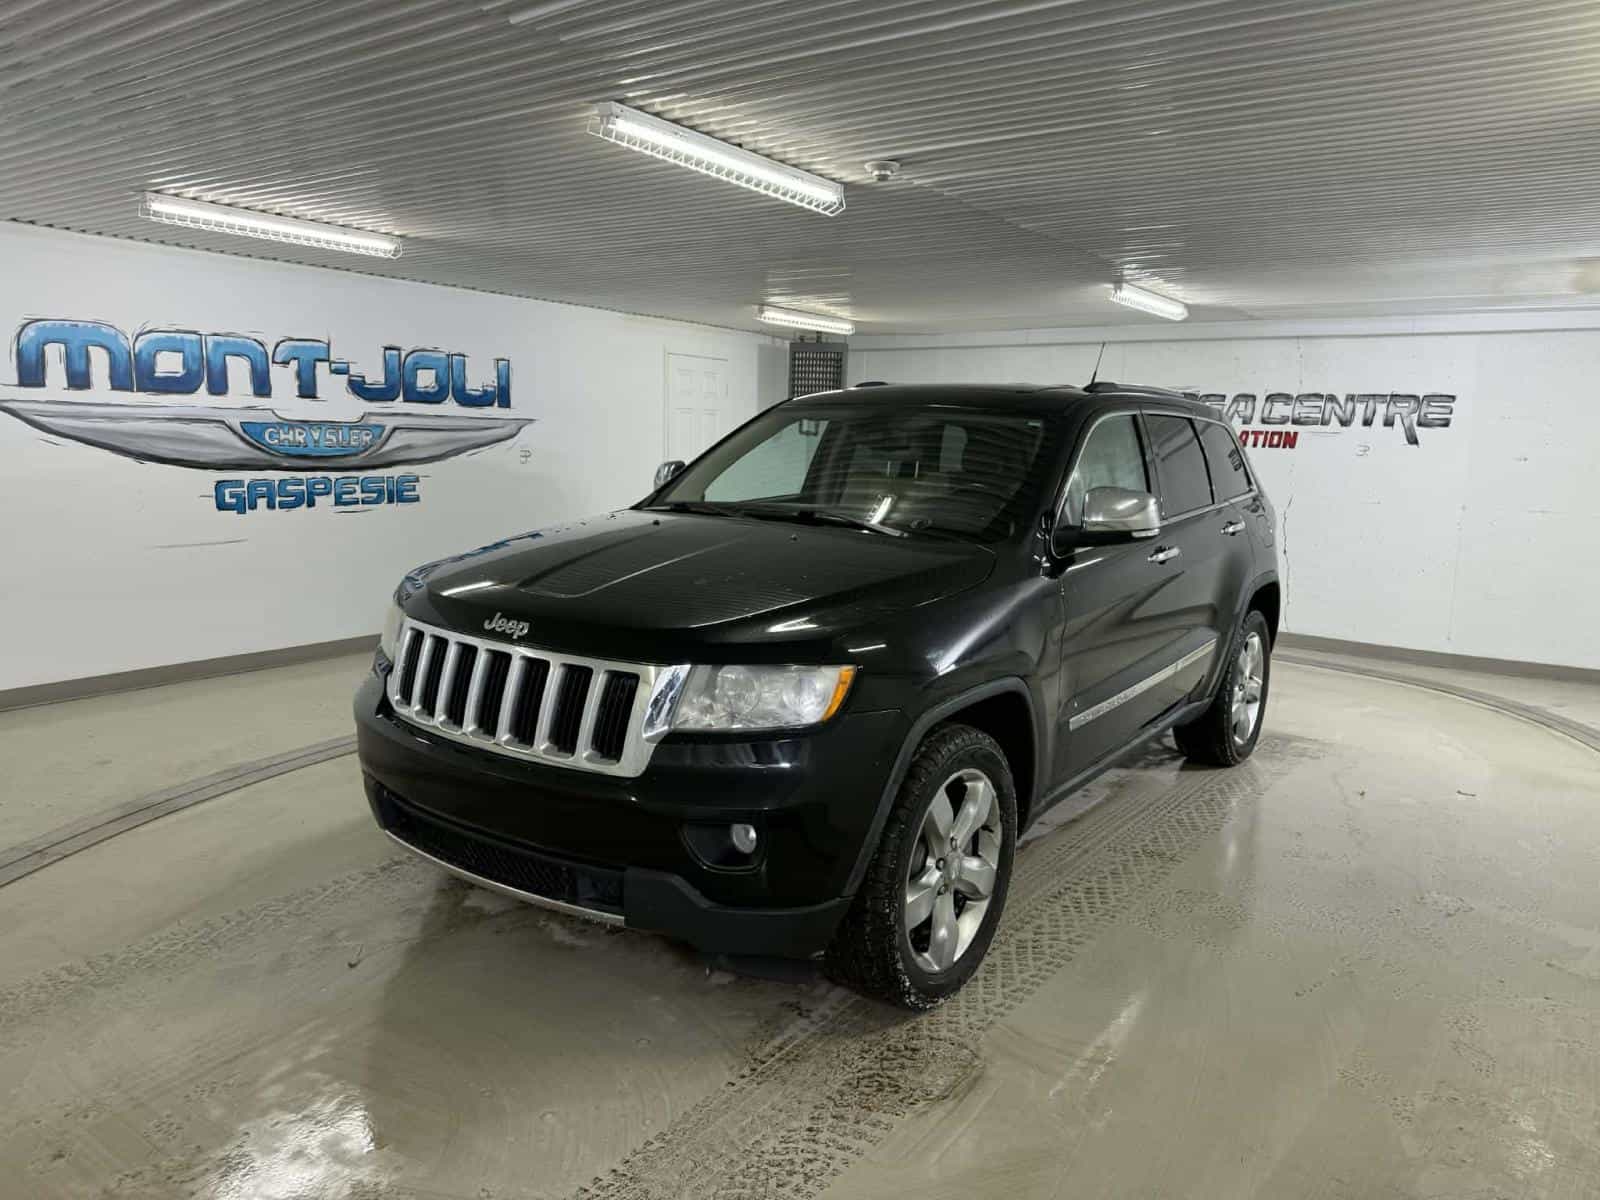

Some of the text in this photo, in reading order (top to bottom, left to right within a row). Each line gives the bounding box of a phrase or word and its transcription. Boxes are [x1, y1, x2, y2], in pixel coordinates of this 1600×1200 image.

[1260, 392, 1457, 446] CENTRE
[264, 427, 375, 448] CHRYSLER
[214, 475, 420, 515] GASPESIE
[483, 611, 531, 640] Jeep
